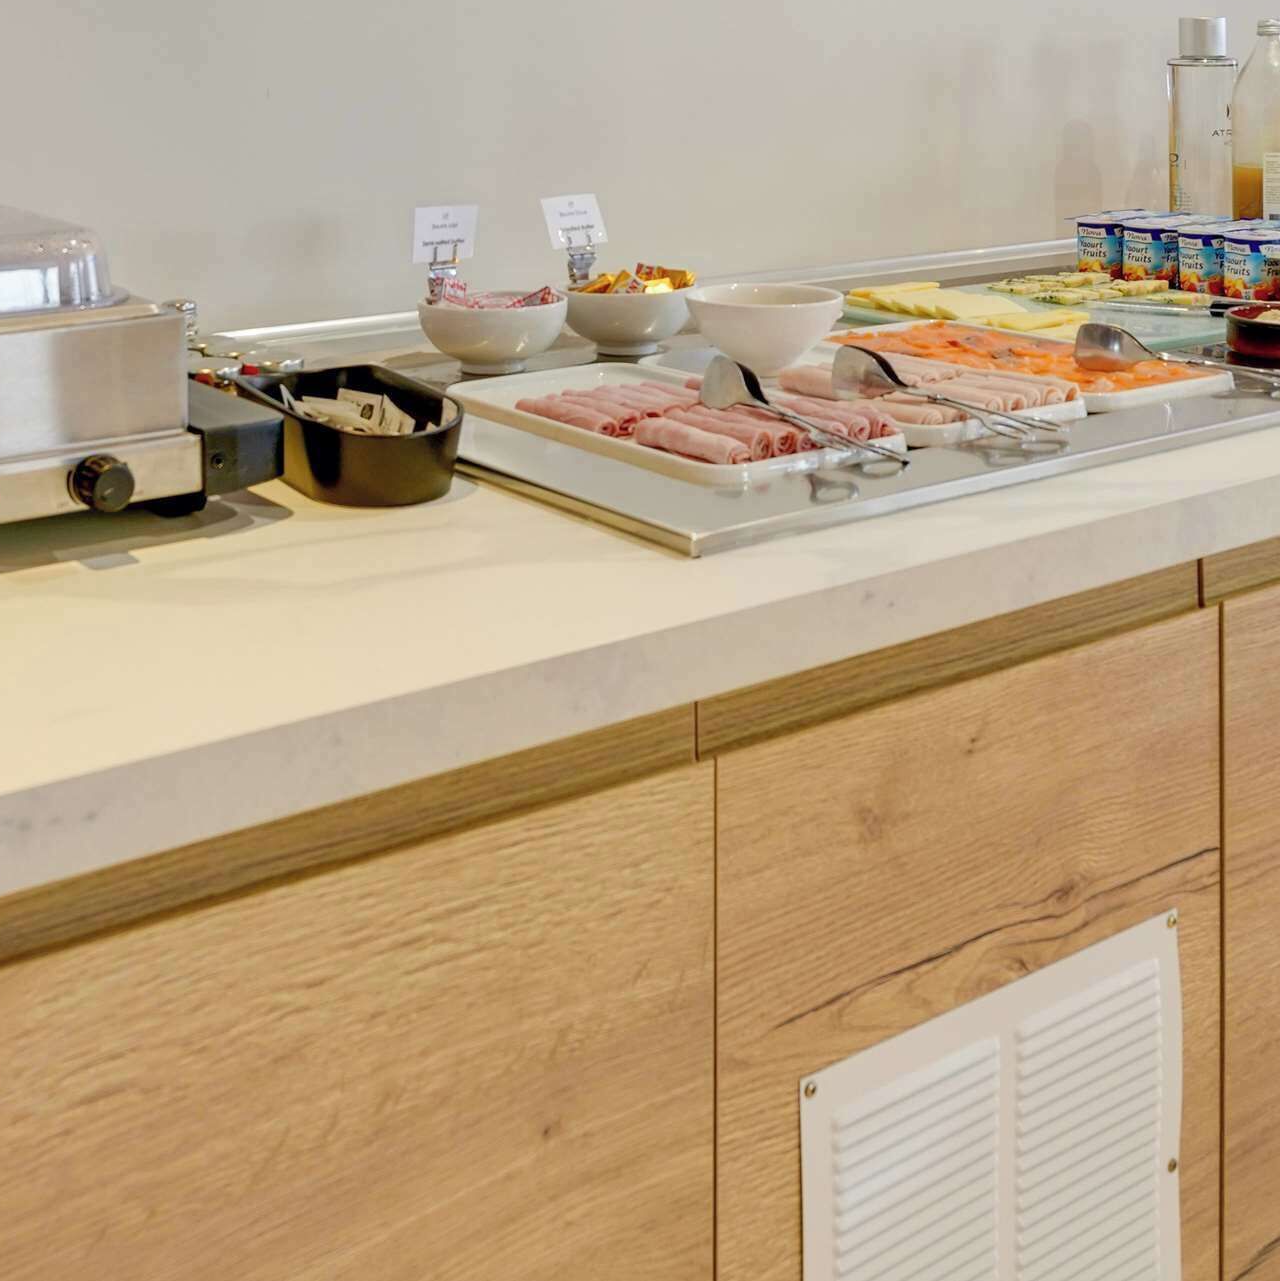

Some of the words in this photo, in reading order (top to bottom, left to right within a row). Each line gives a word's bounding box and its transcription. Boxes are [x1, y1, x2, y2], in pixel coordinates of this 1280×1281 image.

[1080, 239, 1103, 249] Yaourt
[1083, 248, 1107, 258] Fruits
[1127, 252, 1152, 263] Fruits
[1181, 260, 1204, 270] Fruits
[1227, 265, 1250, 276] Fruits
